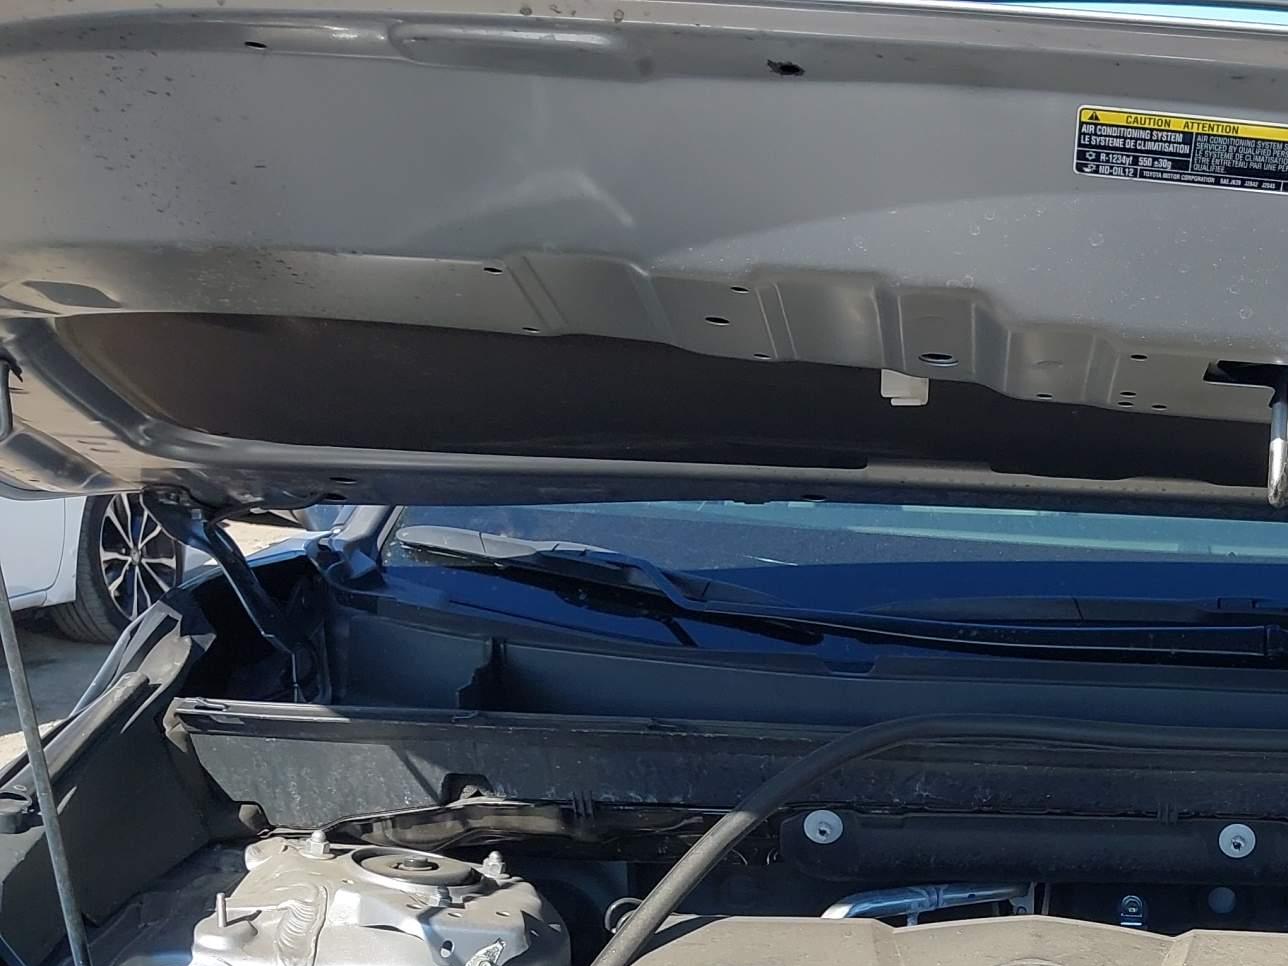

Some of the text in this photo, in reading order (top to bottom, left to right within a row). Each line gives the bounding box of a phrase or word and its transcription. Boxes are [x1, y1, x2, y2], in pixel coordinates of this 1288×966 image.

[1126, 115, 1239, 134] CAUTION ATTENTION
[1082, 124, 1183, 142] AIR CONDITIONING SYSTEM
[1081, 134, 1189, 154] LE SYSTEME DE CLIMATISATION
[1197, 142, 1227, 151] SERVICED
[1239, 147, 1271, 156] QUALIFIED
[1209, 136, 1255, 147] CONDITIONING
[1257, 141, 1282, 149] SYSTEM
[1100, 153, 1171, 169] R-1234yf 550 ±30g
[1264, 163, 1276, 171] UNE
[1181, 174, 1215, 183] CORPORATION
